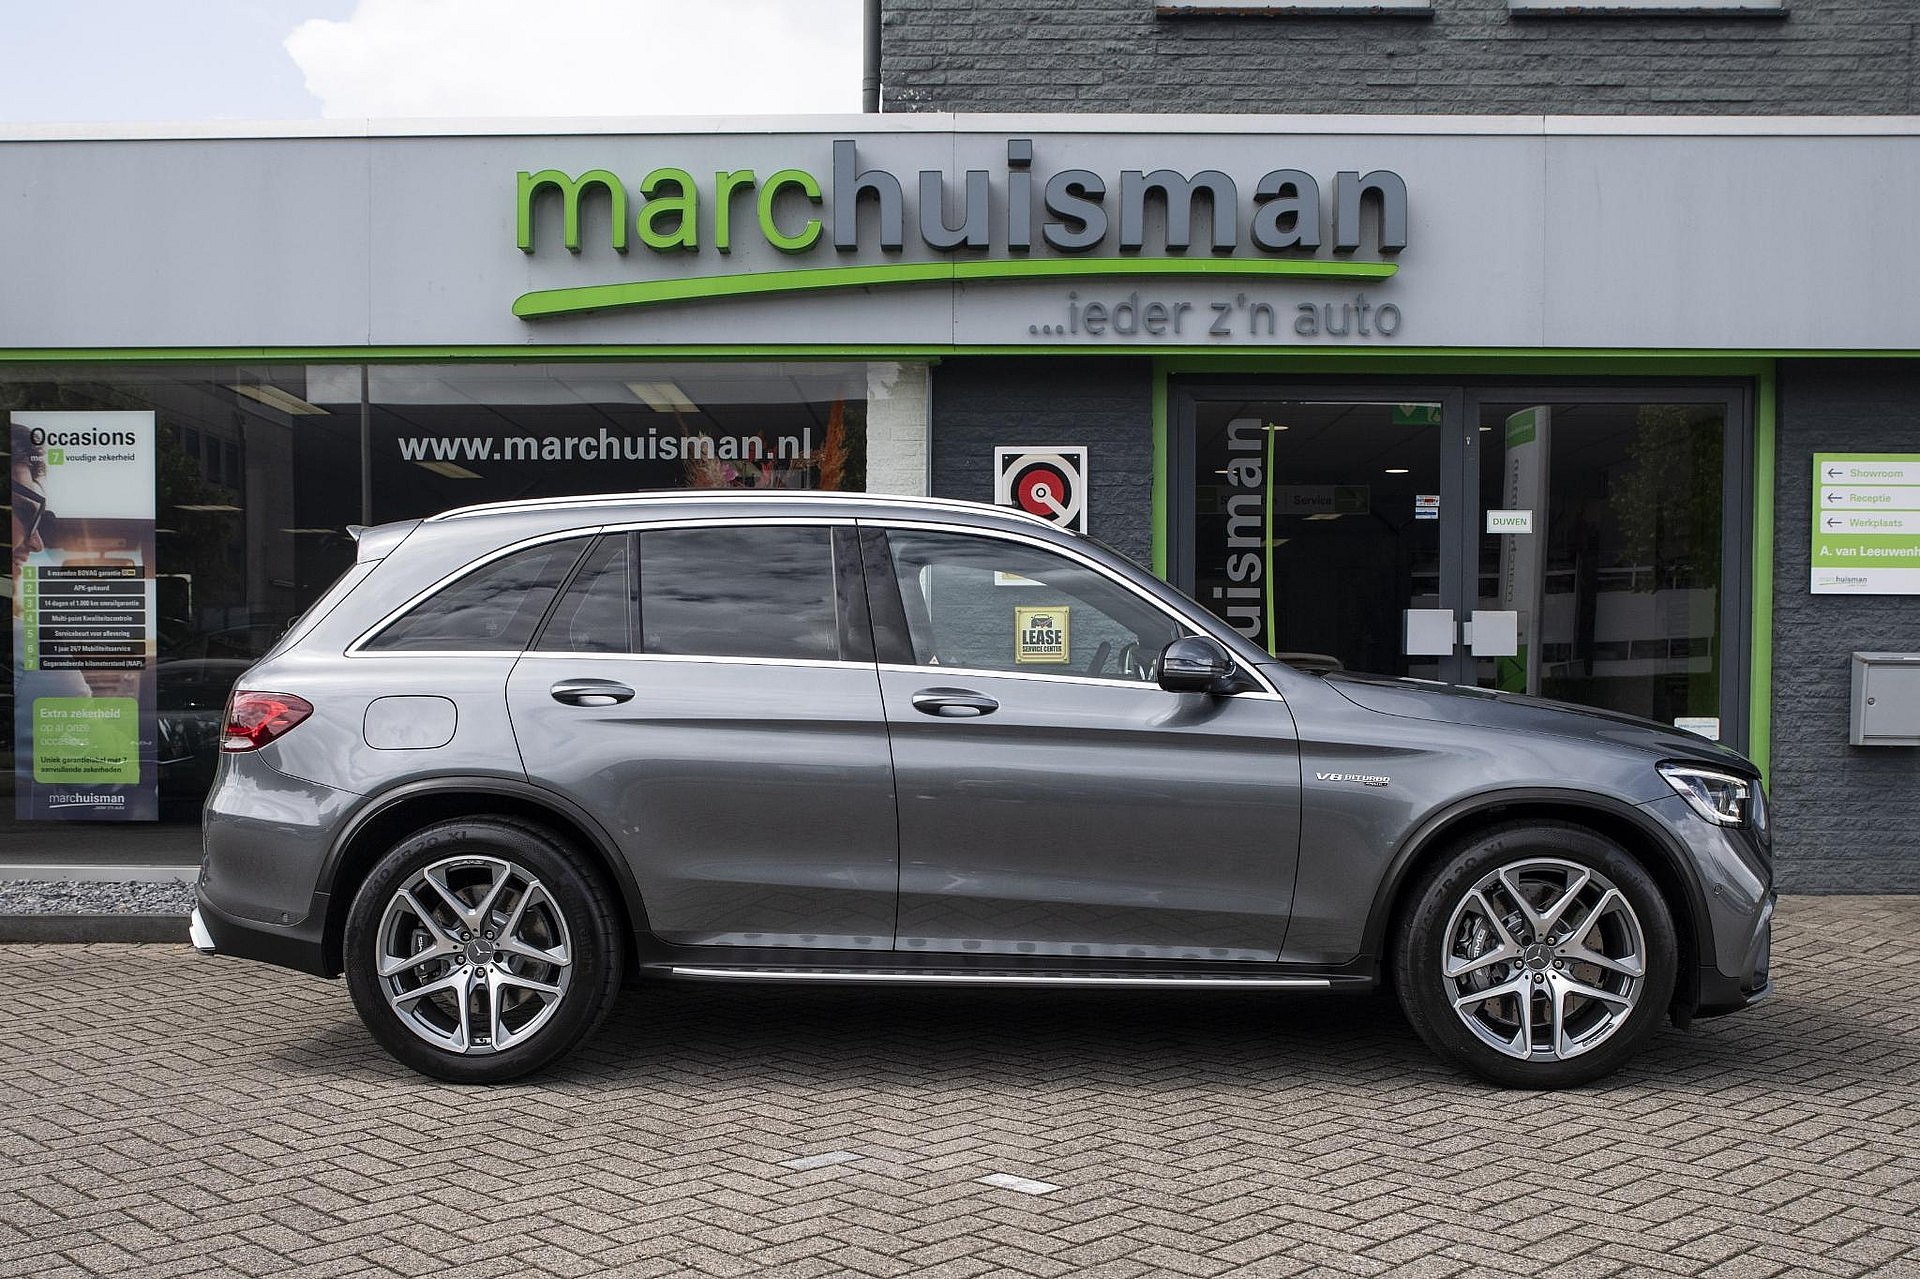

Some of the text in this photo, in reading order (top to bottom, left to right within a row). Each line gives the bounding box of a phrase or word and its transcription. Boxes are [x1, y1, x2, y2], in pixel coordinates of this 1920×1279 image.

[516, 140, 1408, 254] marchuisman
[1029, 291, 1400, 336] ...ieder z'n auto
[31, 427, 135, 446] Occasions
[398, 428, 811, 460] www.marchuisman.nl
[52, 453, 59, 462] 7
[66, 453, 96, 463] voudige
[98, 453, 135, 461] zekerheid
[1850, 468, 1904, 478] Showroom
[1850, 494, 1891, 503] Receptie
[1493, 518, 1527, 526] DUWEN
[1849, 518, 1903, 528] Werkplaats
[1820, 545, 1832, 556] A.
[1836, 548, 1856, 556] van
[98, 570, 121, 578] garantie
[52, 600, 68, 608] dagen
[1022, 629, 1062, 645] LEASE
[40, 708, 120, 718] Extra zekerheid
[40, 724, 53, 733] op
[66, 724, 89, 732] onze
[1316, 772, 1391, 783] V8 BITURBO
[49, 793, 125, 803] marchuisman
